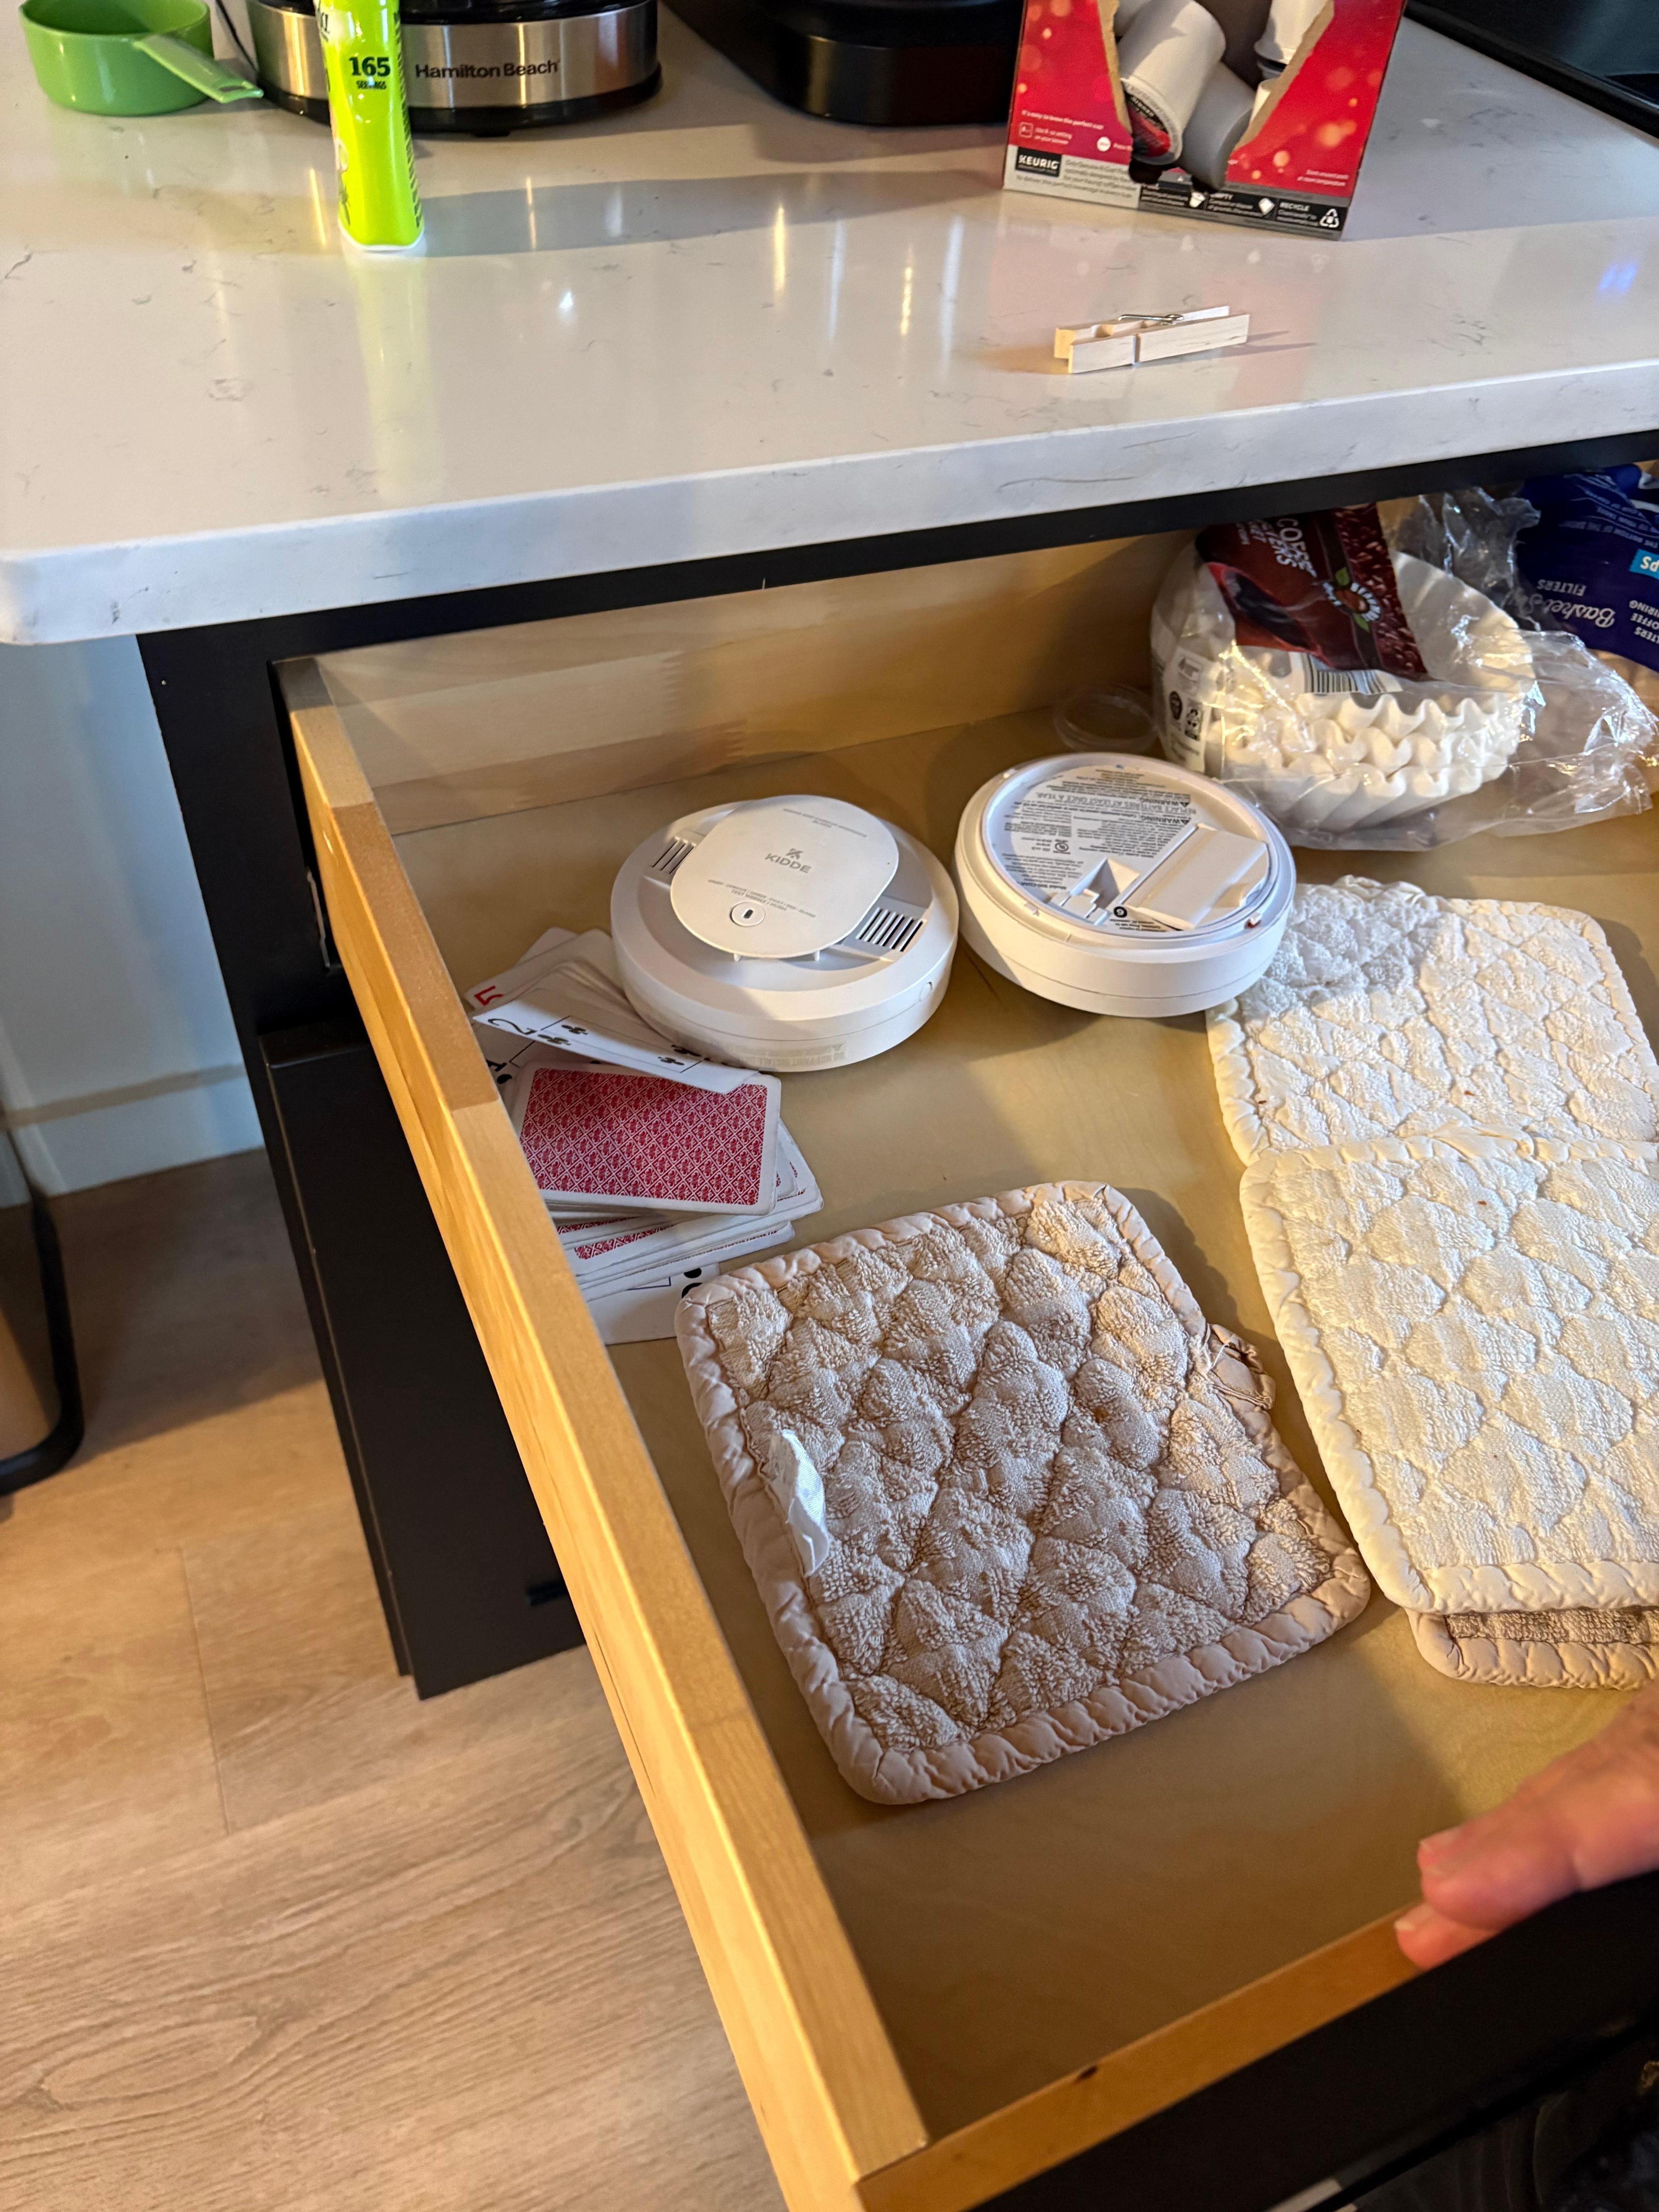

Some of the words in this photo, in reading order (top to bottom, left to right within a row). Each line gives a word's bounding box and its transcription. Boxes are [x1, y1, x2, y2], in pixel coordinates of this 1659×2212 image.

[350, 57, 390, 77] 165
[416, 64, 501, 78] Hamilton
[503, 60, 558, 77] Beach
[356, 81, 386, 89] SERNGS
[1019, 155, 1059, 170] KEURIG
[1279, 201, 1310, 211] RECYCLE
[1639, 555, 1659, 572] PS
[1537, 579, 1587, 596] FILTERS
[1543, 598, 1616, 628] Basket
[764, 853, 812, 874] KIDDE
[488, 1018, 538, 1036] 2
